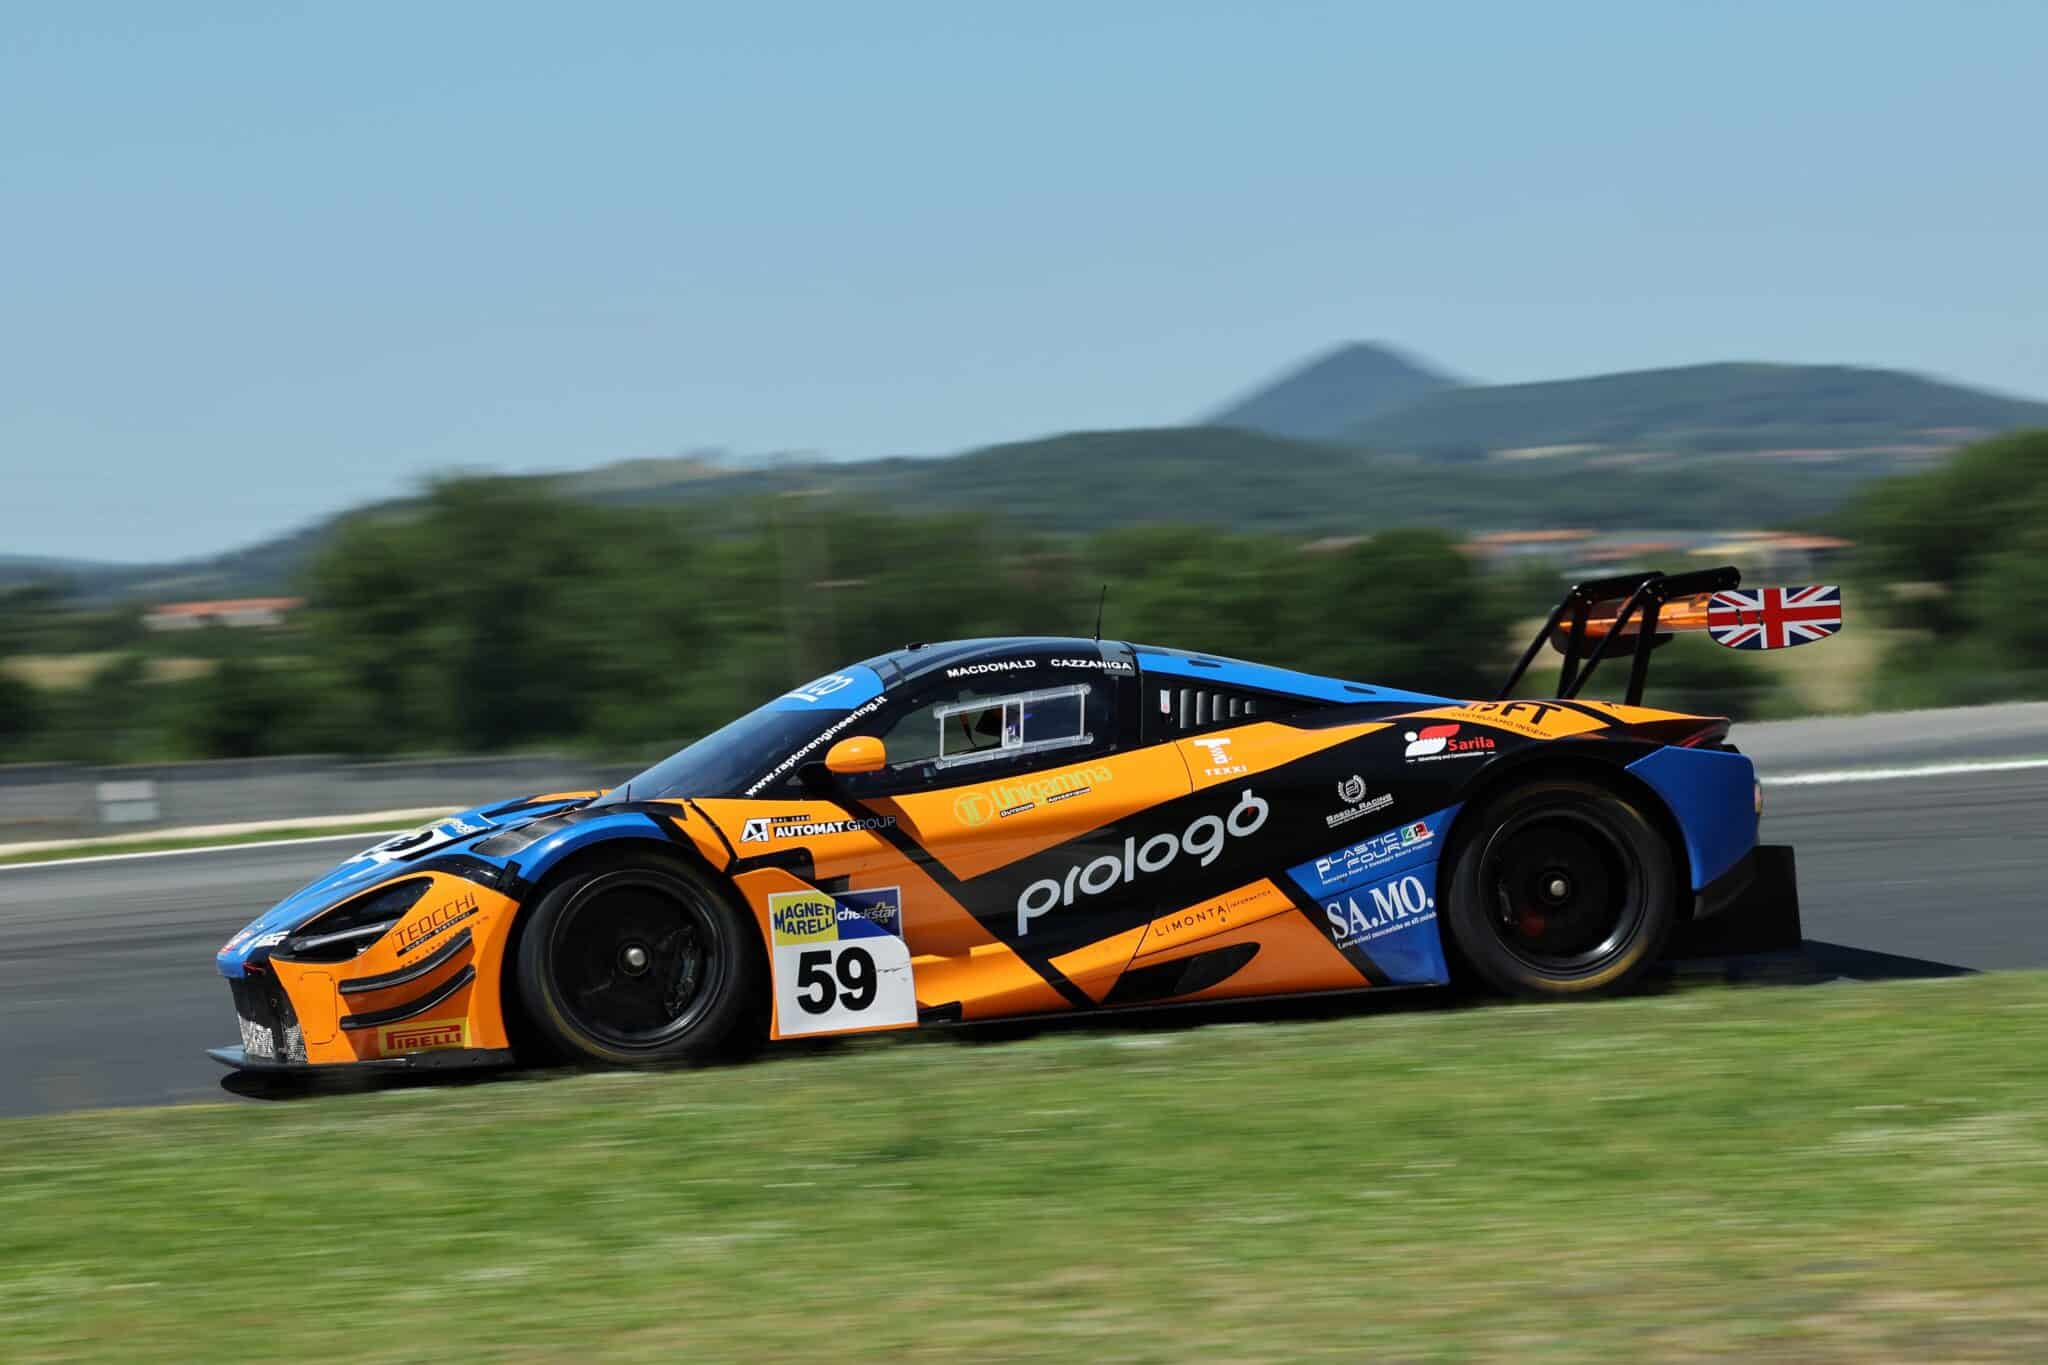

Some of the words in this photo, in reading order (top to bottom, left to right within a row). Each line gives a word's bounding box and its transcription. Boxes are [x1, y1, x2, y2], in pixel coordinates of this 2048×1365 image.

[946, 659, 1036, 678] MACDONALD
[1051, 658, 1132, 671] CAZZANIGA
[745, 695, 888, 797] www.raptorengineering.it
[1448, 736, 1496, 751] Sarila
[991, 766, 1113, 807] Unigamma
[775, 822, 844, 838] AUTOMAT
[847, 815, 896, 831] GROUP
[1017, 788, 1269, 936] prologo
[1316, 832, 1398, 880] PLASTIC
[1347, 842, 1401, 869] FOUR
[395, 892, 476, 946] TEOCCHI
[773, 902, 836, 926] MAGNETI
[773, 913, 836, 935] MARELLI
[1155, 904, 1226, 937] LIMONTA
[1327, 876, 1434, 942] SA.MO.
[797, 947, 877, 1015] 59
[386, 1025, 462, 1050] PIRELLI
